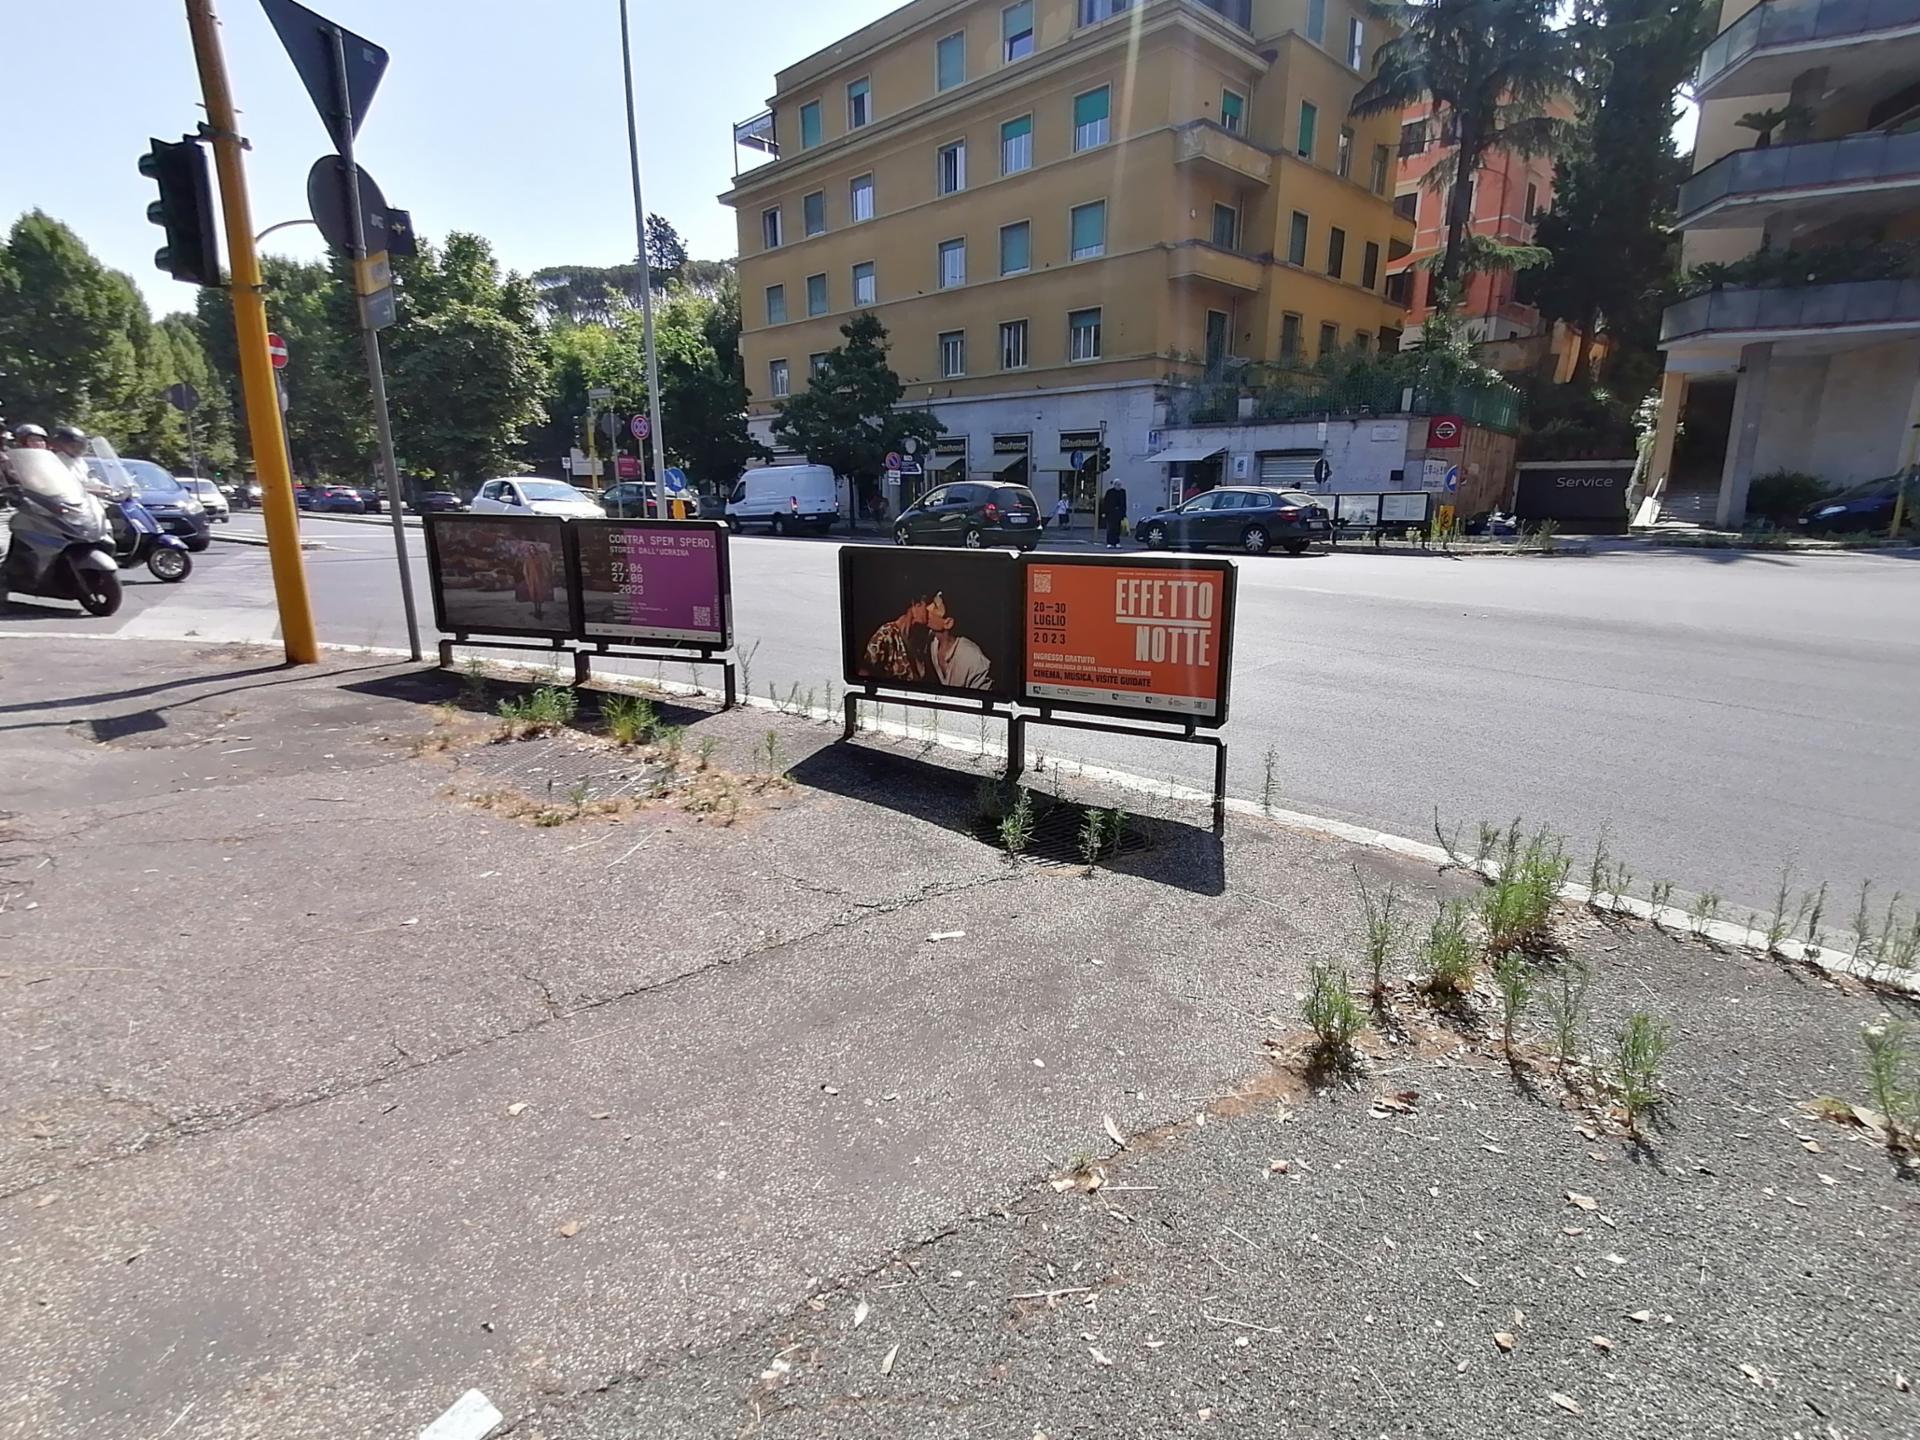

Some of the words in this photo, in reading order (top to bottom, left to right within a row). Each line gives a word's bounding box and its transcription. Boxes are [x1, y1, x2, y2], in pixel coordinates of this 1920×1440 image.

[1556, 476, 1614, 488] Service
[608, 534, 645, 544] CONTRA
[650, 536, 674, 546] SPEM
[680, 537, 715, 549] SPERO.
[610, 546, 635, 554] STORIE
[638, 547, 689, 556] DALL'UCRAINA
[611, 562, 643, 573] 27.06
[612, 573, 644, 584] 27.08
[1116, 578, 1214, 620] EFFETTO
[1034, 614, 1066, 627] LUGLIO
[1136, 626, 1212, 666] NOTTE
[1033, 652, 1064, 662] INGRESSO
[1064, 654, 1096, 664] GRATUITO
[1033, 670, 1063, 680] CINEMA,
[1064, 672, 1094, 683] MUSICA,
[1096, 674, 1119, 684] VISITE
[1120, 676, 1152, 688] GUIDATE
